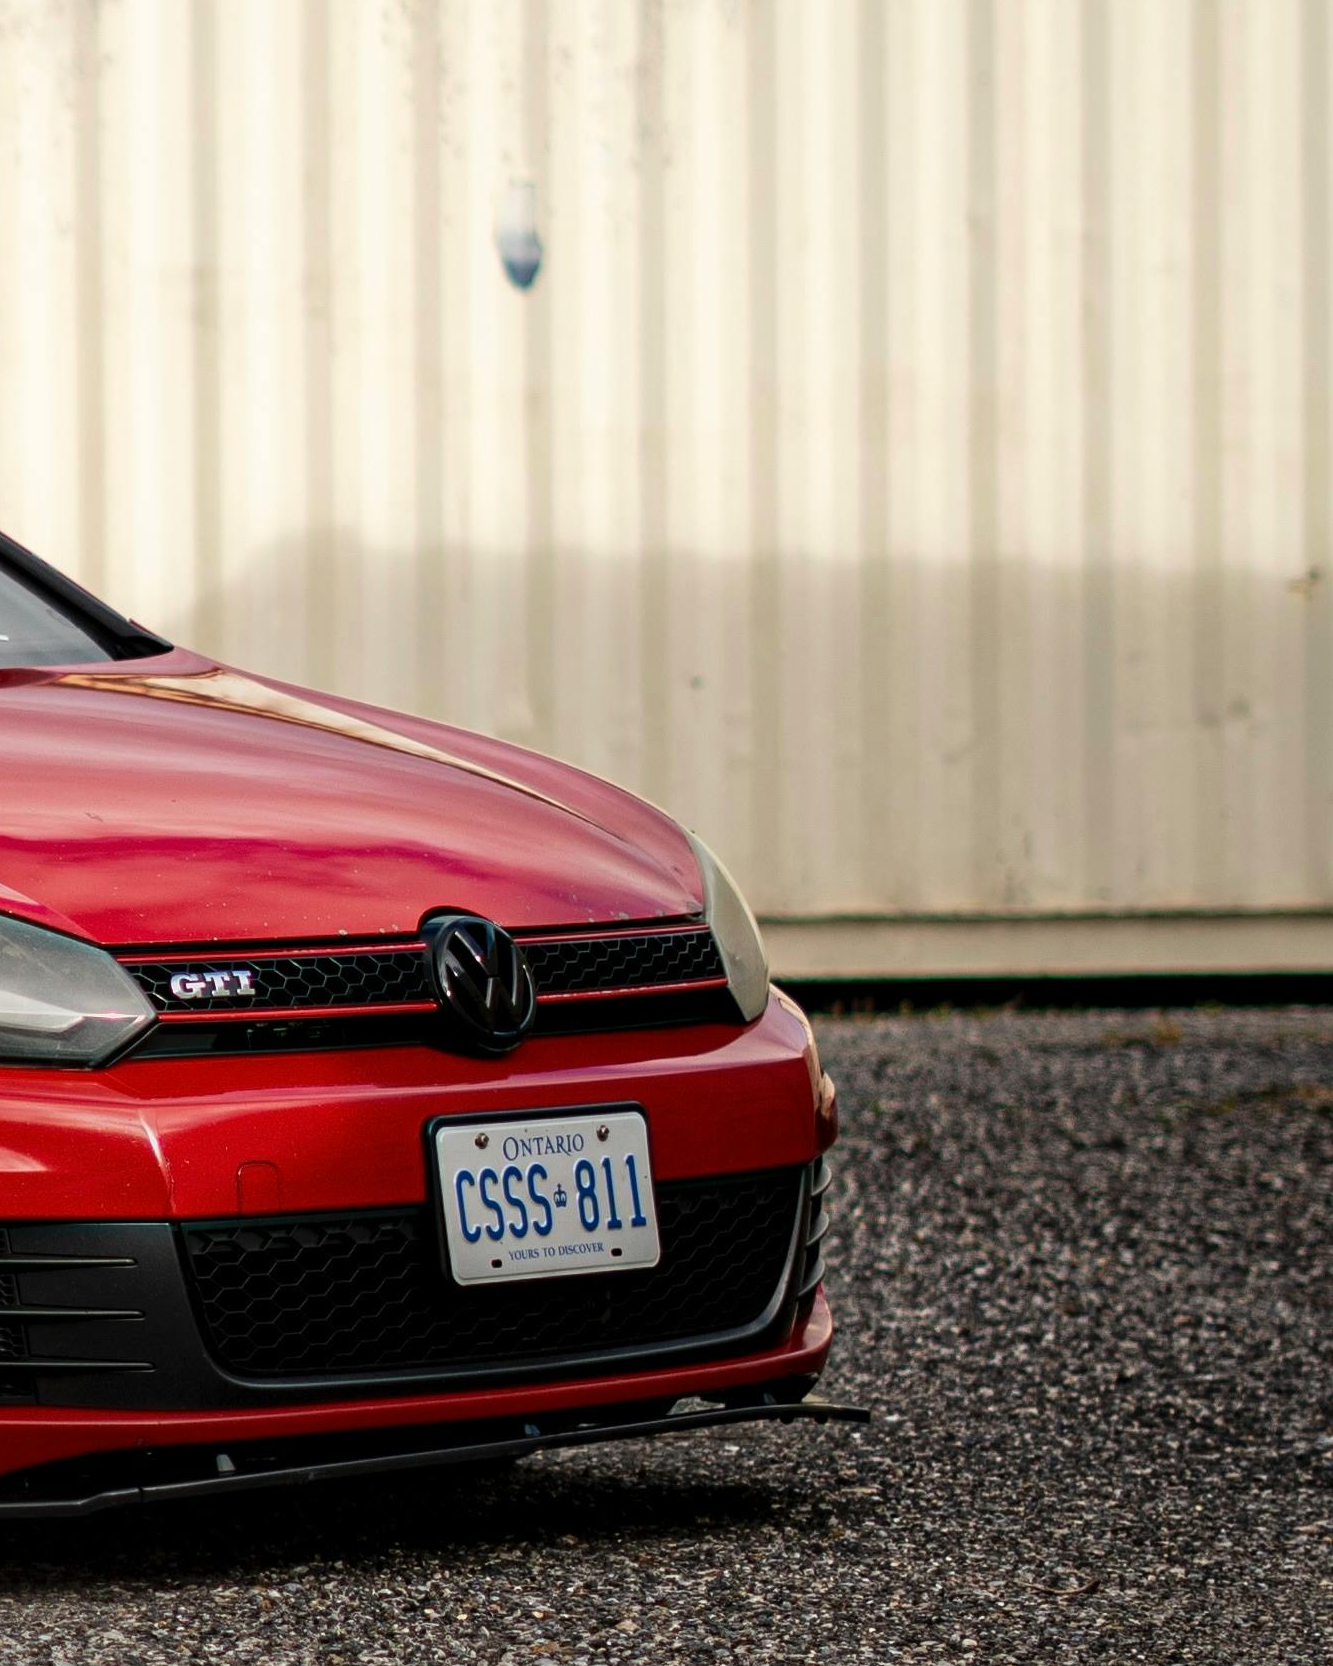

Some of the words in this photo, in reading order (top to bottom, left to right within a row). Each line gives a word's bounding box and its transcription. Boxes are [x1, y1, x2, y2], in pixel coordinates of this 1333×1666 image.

[170, 970, 256, 1000] GTI
[502, 1133, 584, 1162] ONTARIO
[454, 1163, 553, 1243] CSSS
[574, 1154, 647, 1232] 811
[508, 1247, 540, 1261] YOURS
[542, 1246, 556, 1258] TO
[558, 1242, 605, 1256] DISCOVER
